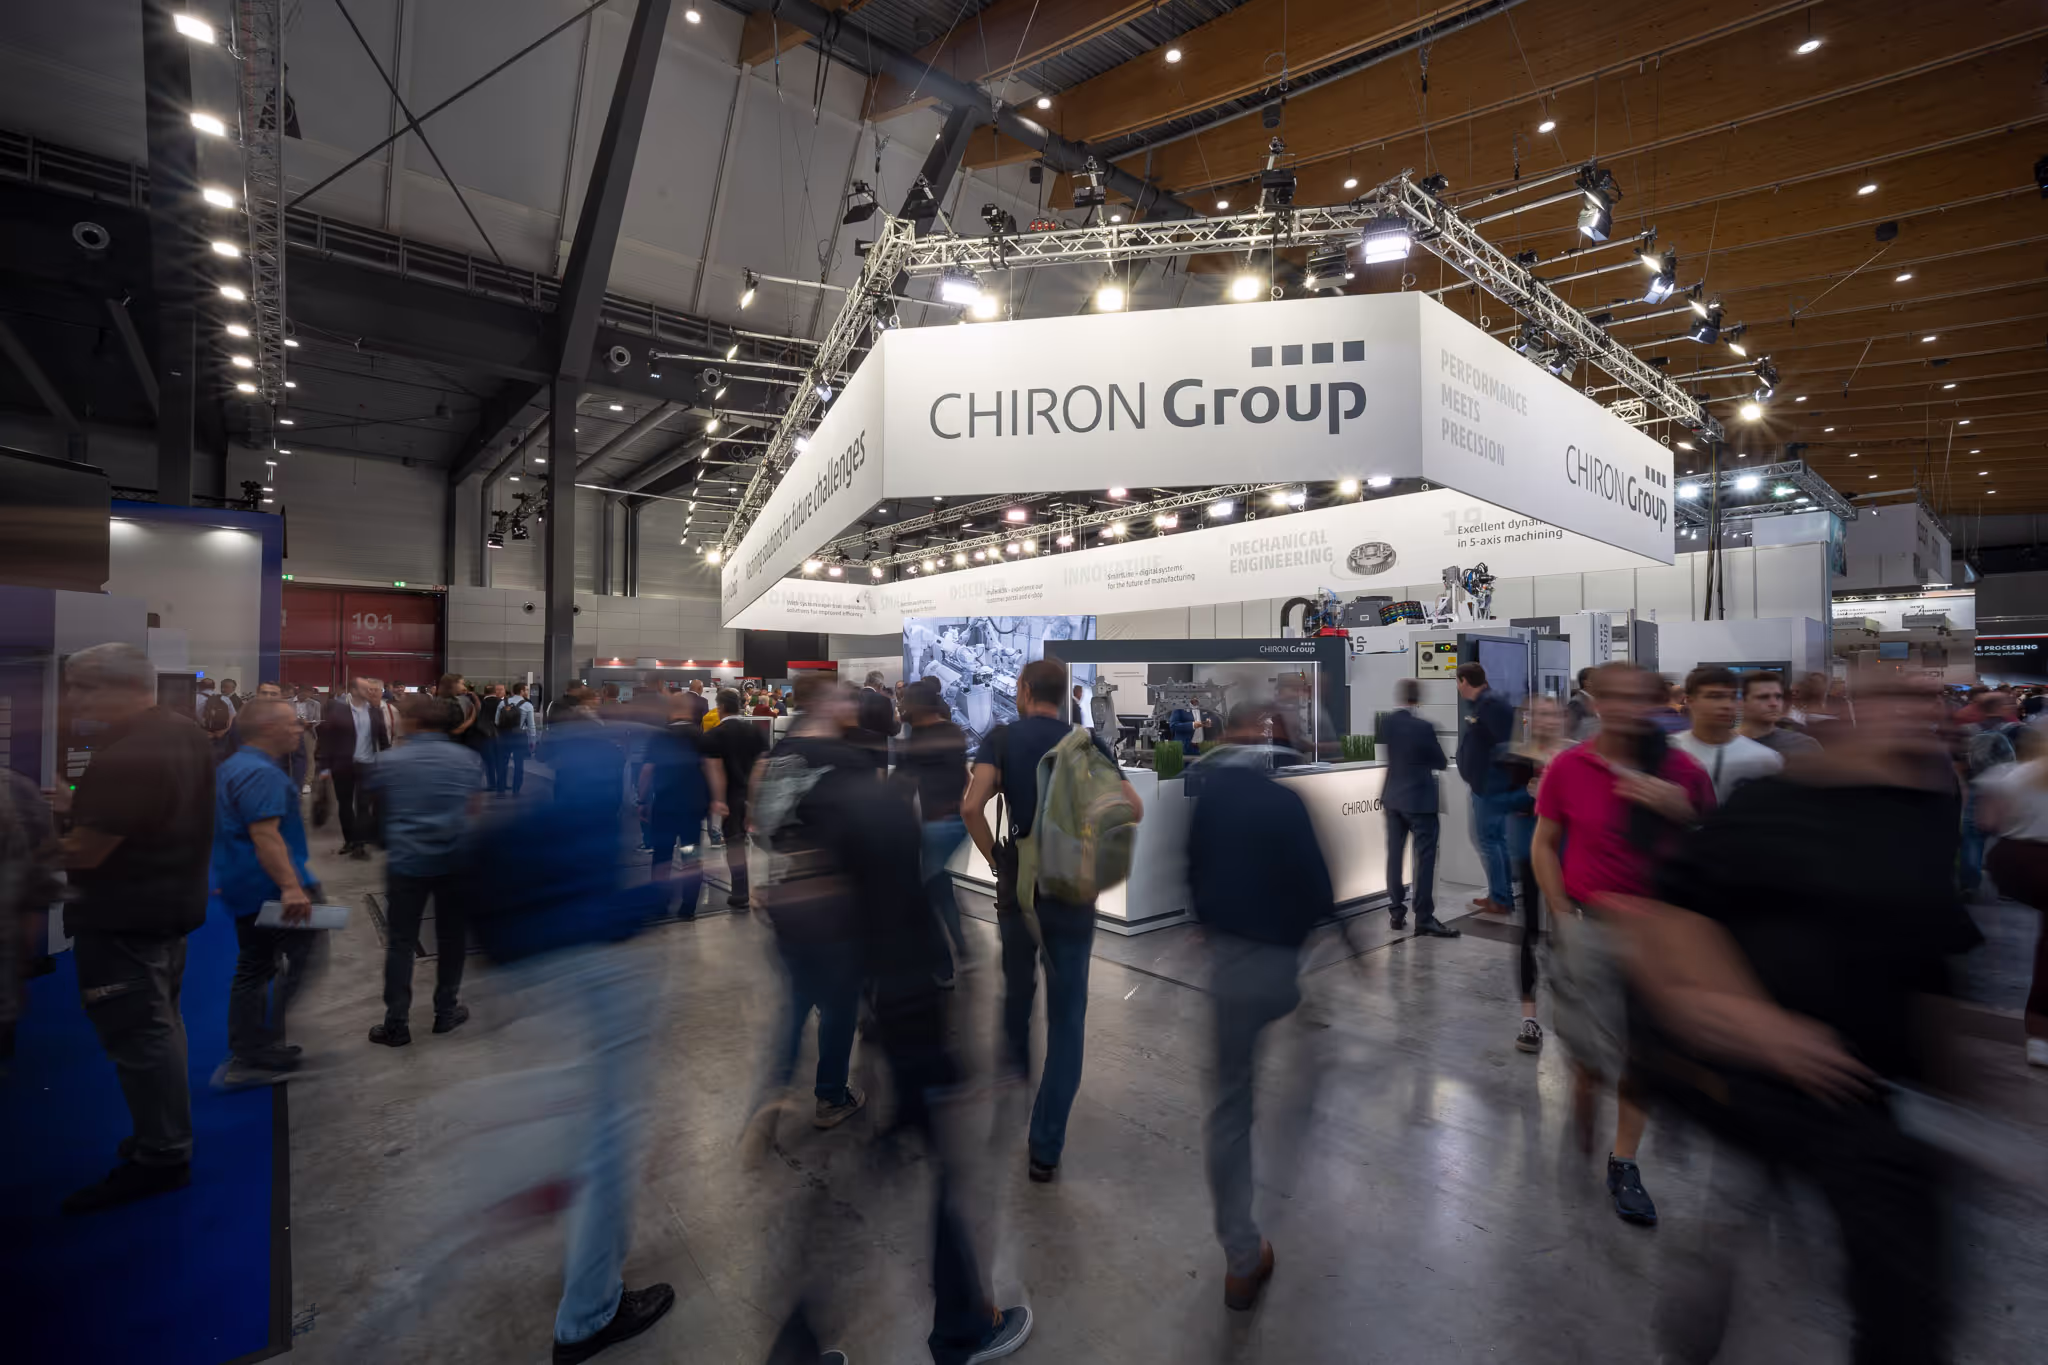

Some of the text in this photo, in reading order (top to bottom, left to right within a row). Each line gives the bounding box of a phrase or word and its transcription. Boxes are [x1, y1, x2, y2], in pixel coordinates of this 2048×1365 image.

[1441, 348, 1528, 417] PERFORMANCE
[930, 378, 1367, 439] CHIRON Group
[1441, 383, 1481, 423] MEETS
[1442, 418, 1505, 466] PRECISION
[783, 513, 792, 542] for
[792, 491, 813, 534] future
[814, 429, 866, 512] challenges
[1566, 444, 1667, 533] CHIRON Group
[1457, 521, 1505, 535] Excellent
[1457, 528, 1563, 548] in 5-axis machining
[1230, 529, 1328, 557] MECHANICAL
[1139, 567, 1158, 577] digital
[1158, 564, 1183, 575] systems
[1230, 547, 1334, 575] ENGINEERING
[1107, 573, 1196, 591] for the future of manufacturing
[1260, 645, 1315, 655] CHIRON Group
[1342, 799, 1373, 816] CHIRON
